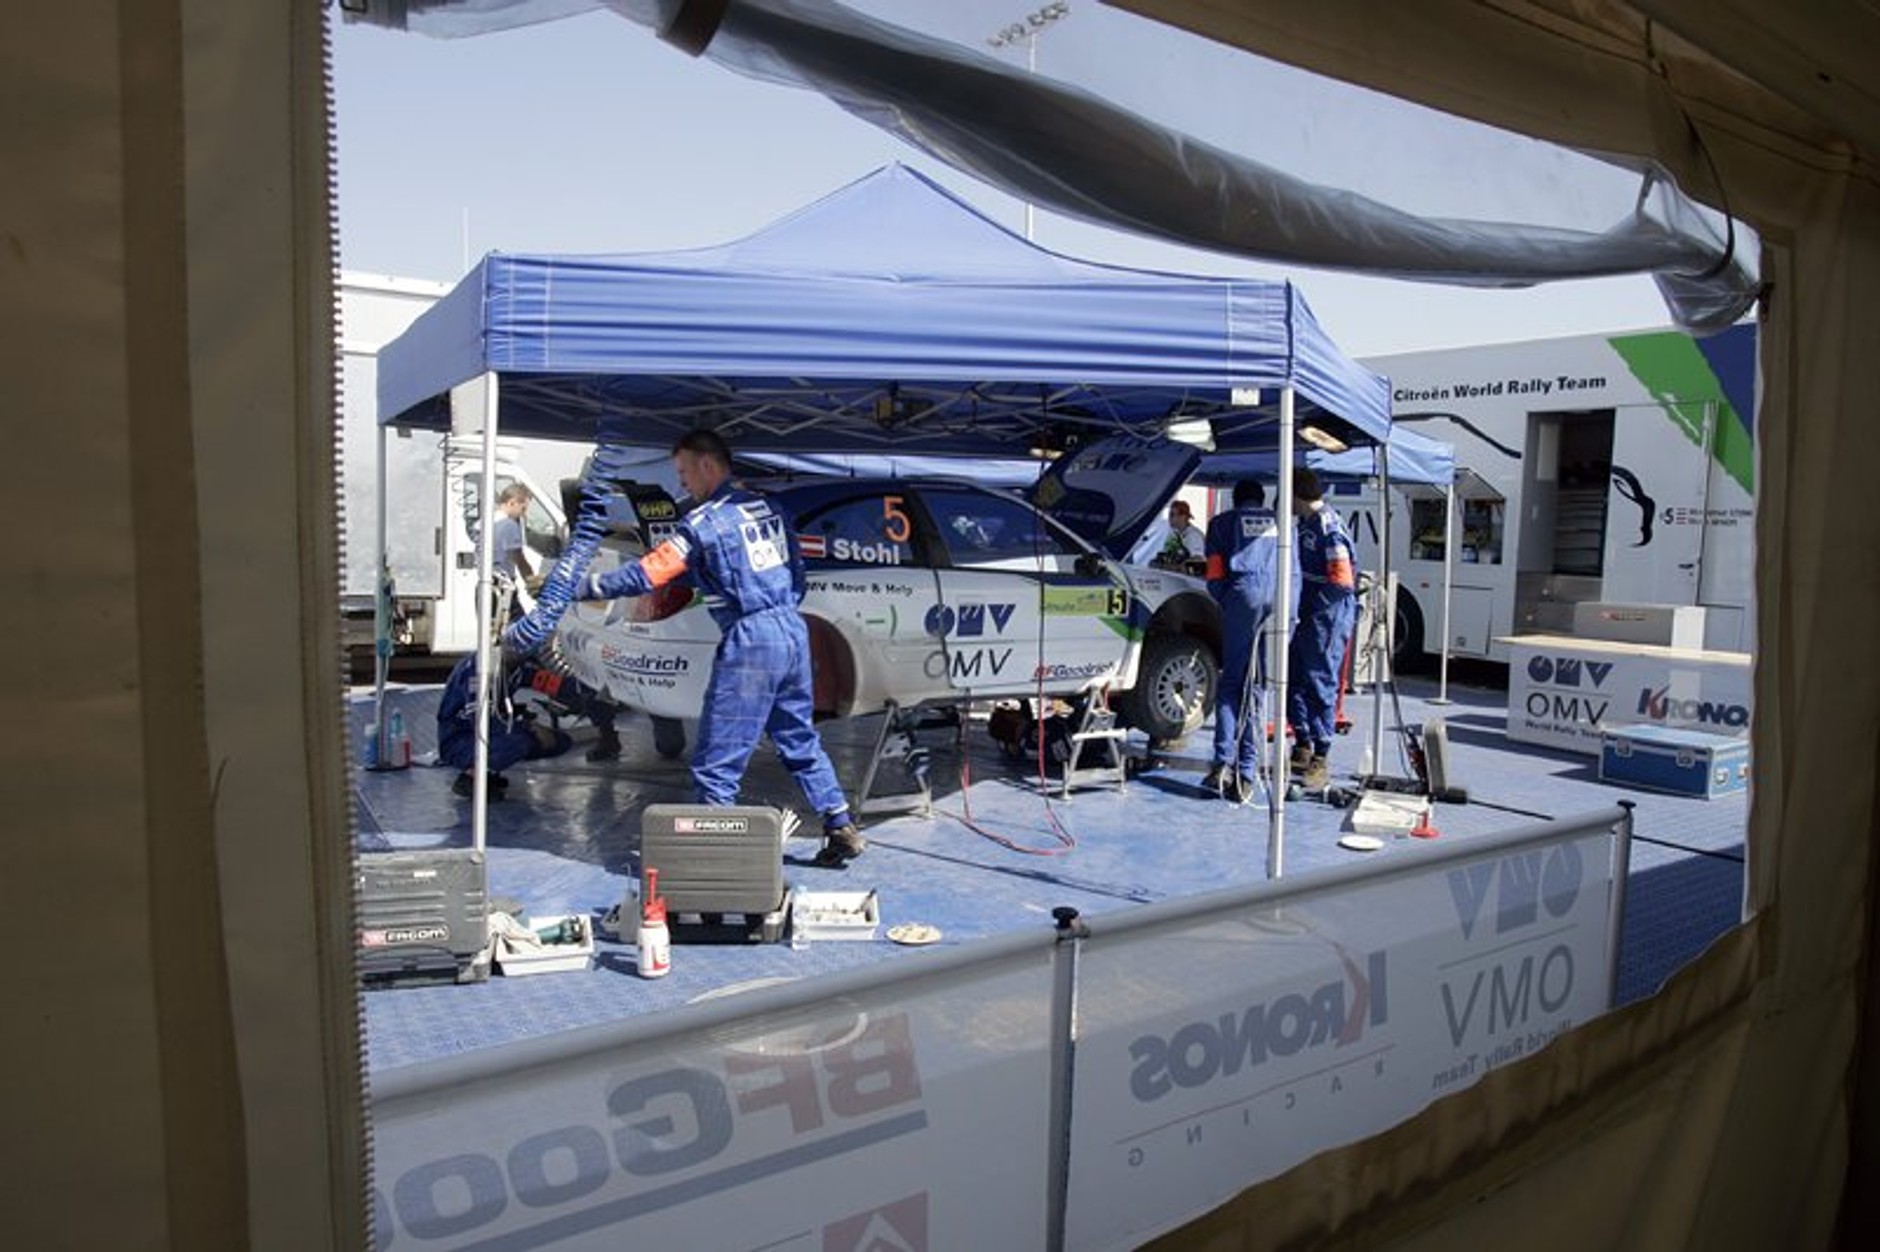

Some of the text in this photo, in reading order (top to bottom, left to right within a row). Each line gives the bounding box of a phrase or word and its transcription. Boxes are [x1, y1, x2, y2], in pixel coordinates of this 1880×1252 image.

[1393, 376, 1606, 402] Citroën World Rally Team
[883, 496, 911, 542] 5
[833, 538, 900, 565] Stohl
[872, 583, 881, 594] &
[885, 584, 913, 598] Help
[1108, 589, 1126, 615] 5
[924, 603, 1016, 637] OMV
[923, 648, 1012, 679] OMV
[1527, 655, 1614, 689] OMV
[1526, 692, 1608, 726] OMV
[1637, 683, 1749, 728] KRONO
